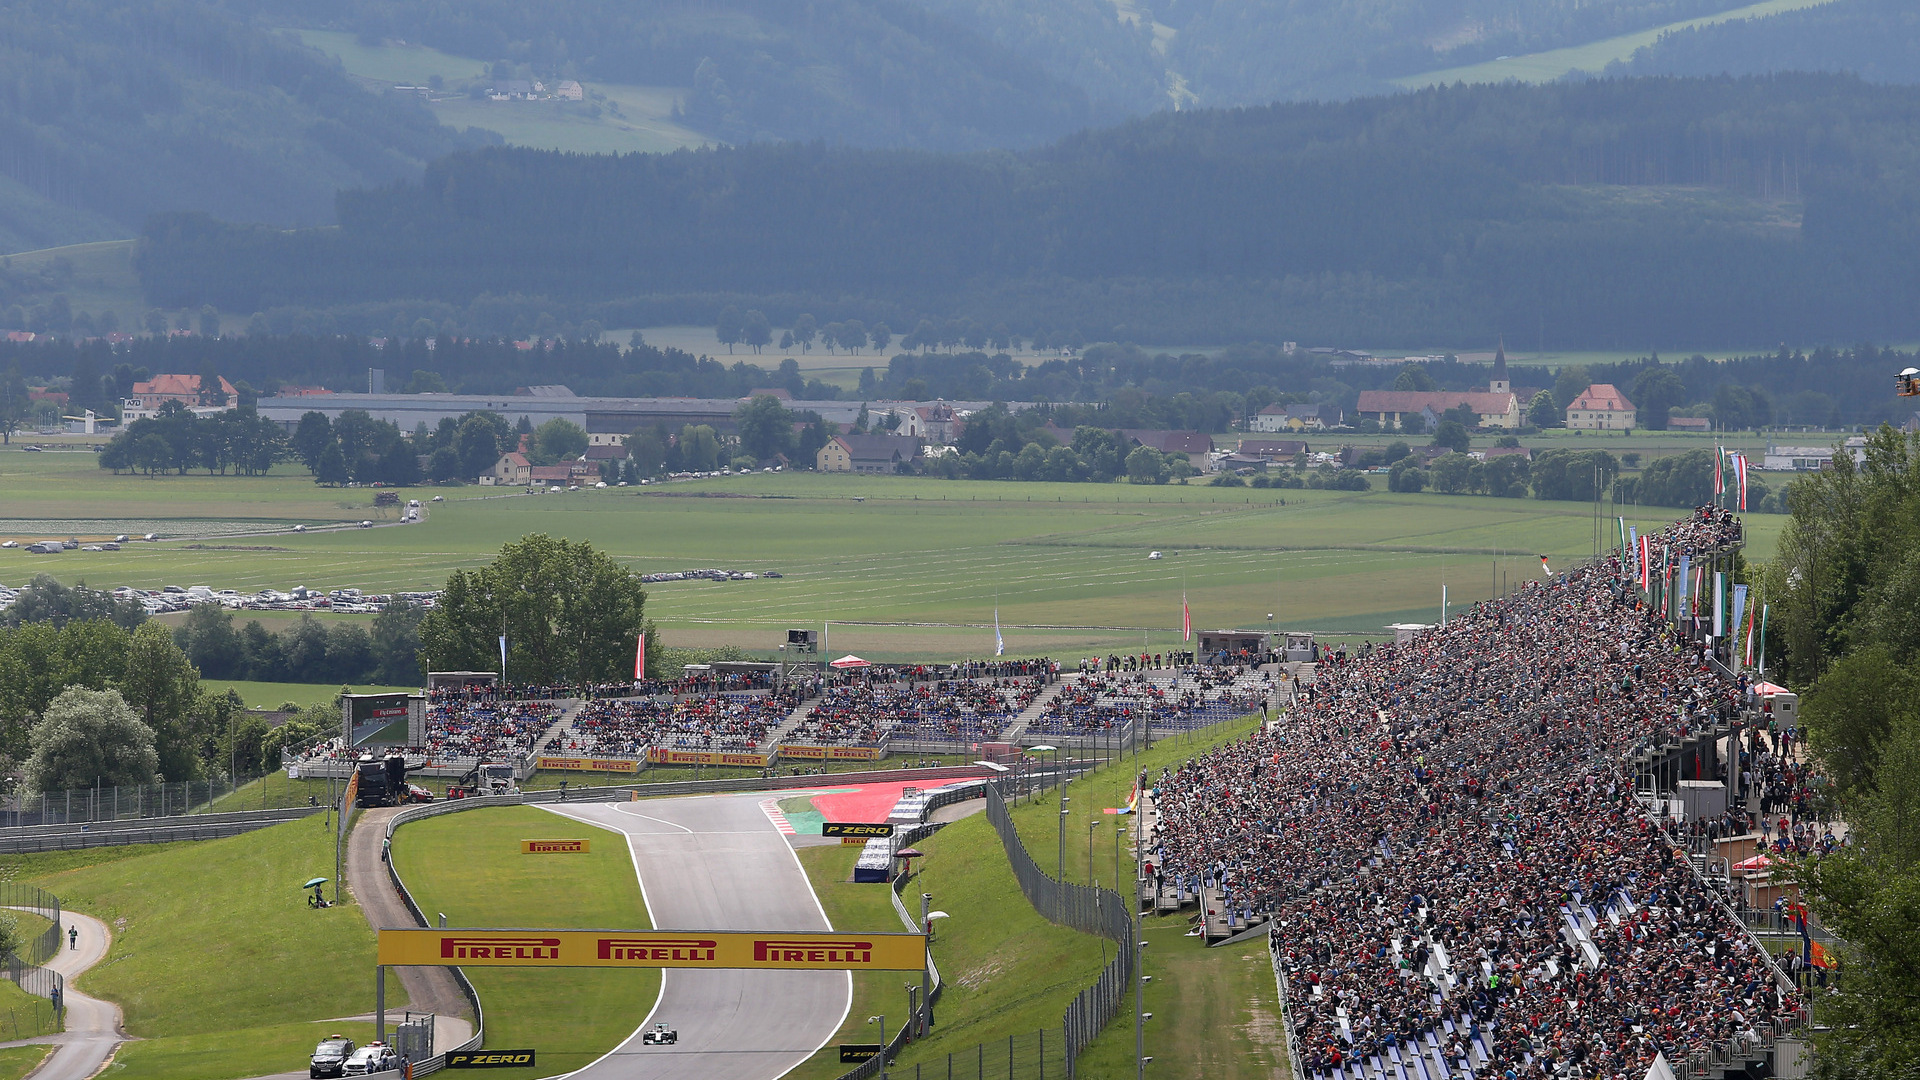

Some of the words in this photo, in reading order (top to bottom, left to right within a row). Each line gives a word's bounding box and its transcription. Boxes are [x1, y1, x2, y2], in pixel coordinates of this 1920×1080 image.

[784, 747, 822, 757] PIRELLI
[833, 748, 873, 758] PIRELLI
[672, 753, 711, 763] PIRELLI
[722, 754, 762, 764] PIRELLI
[543, 759, 581, 768] PIRELLI
[592, 761, 631, 770] PIRELLI
[842, 826, 890, 834] ZERO
[529, 842, 581, 851] PIRELLI
[441, 938, 561, 958] PIRELLI
[598, 939, 717, 960] PIRELLI
[754, 941, 873, 962] PIRELLI
[451, 1056, 468, 1064] P
[470, 1054, 531, 1064] ZERO
